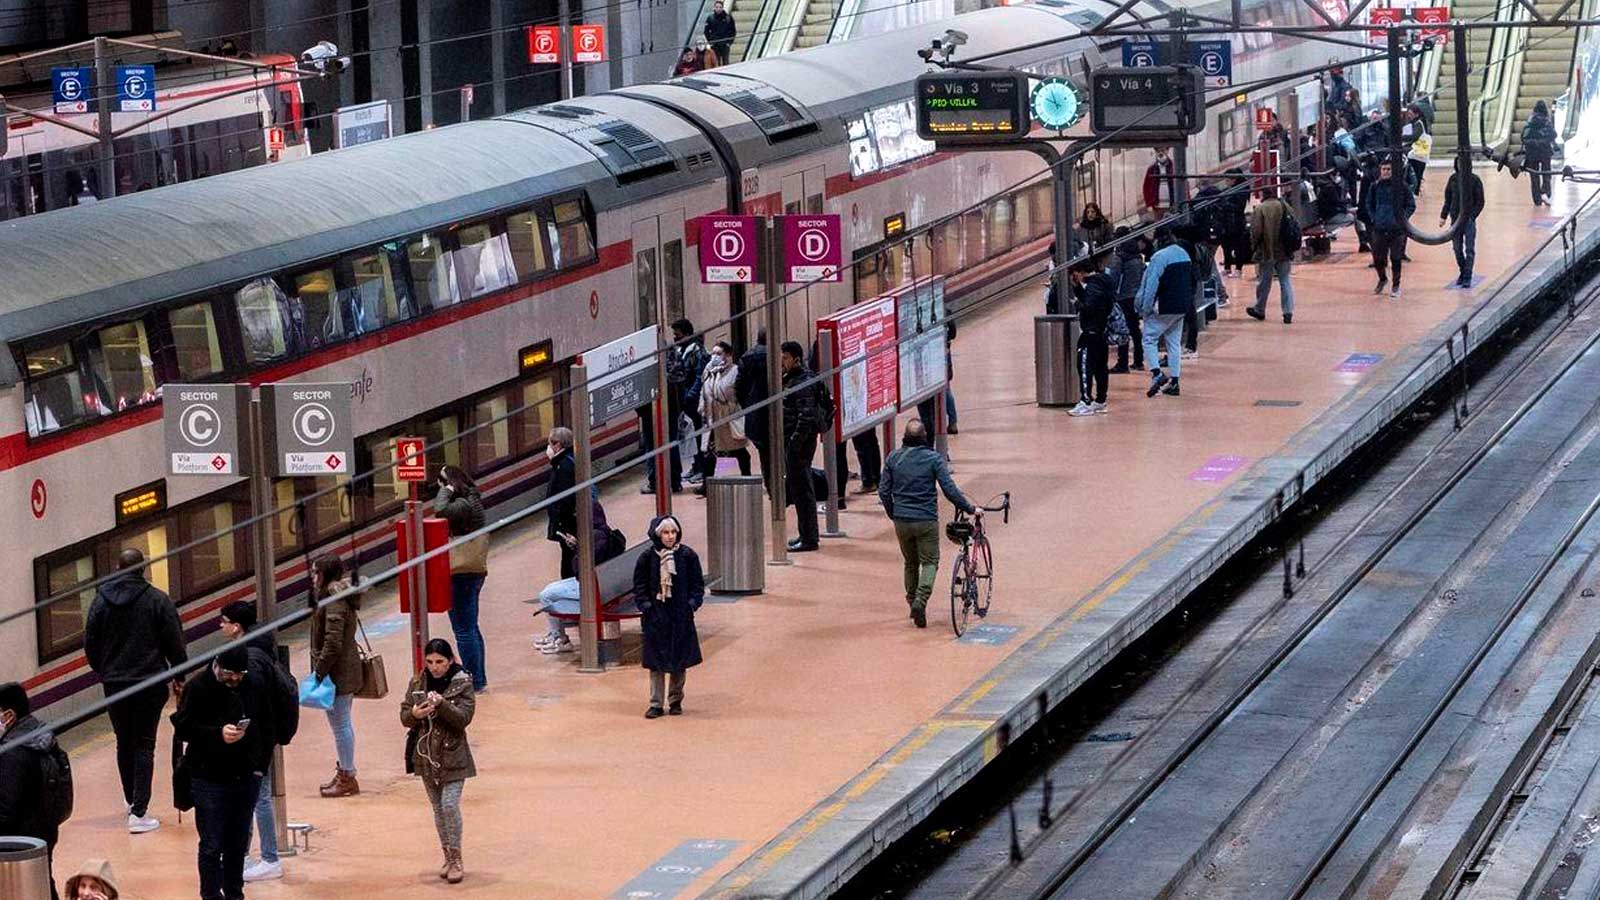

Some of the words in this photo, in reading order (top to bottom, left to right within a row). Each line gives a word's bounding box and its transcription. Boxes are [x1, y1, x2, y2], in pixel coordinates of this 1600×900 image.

[1206, 55, 1217, 71] E
[65, 81, 76, 96] E
[971, 82, 979, 94] 3
[1144, 79, 1152, 90] 4
[798, 220, 828, 228] SECTOR
[720, 234, 739, 257] D
[805, 234, 824, 256] D
[351, 368, 373, 404] enfe
[180, 391, 218, 401] SECTOR
[292, 390, 332, 400] SECTOR
[188, 410, 213, 440] C
[301, 409, 327, 439] C
[214, 457, 223, 468] 3
[328, 456, 337, 467] 4
